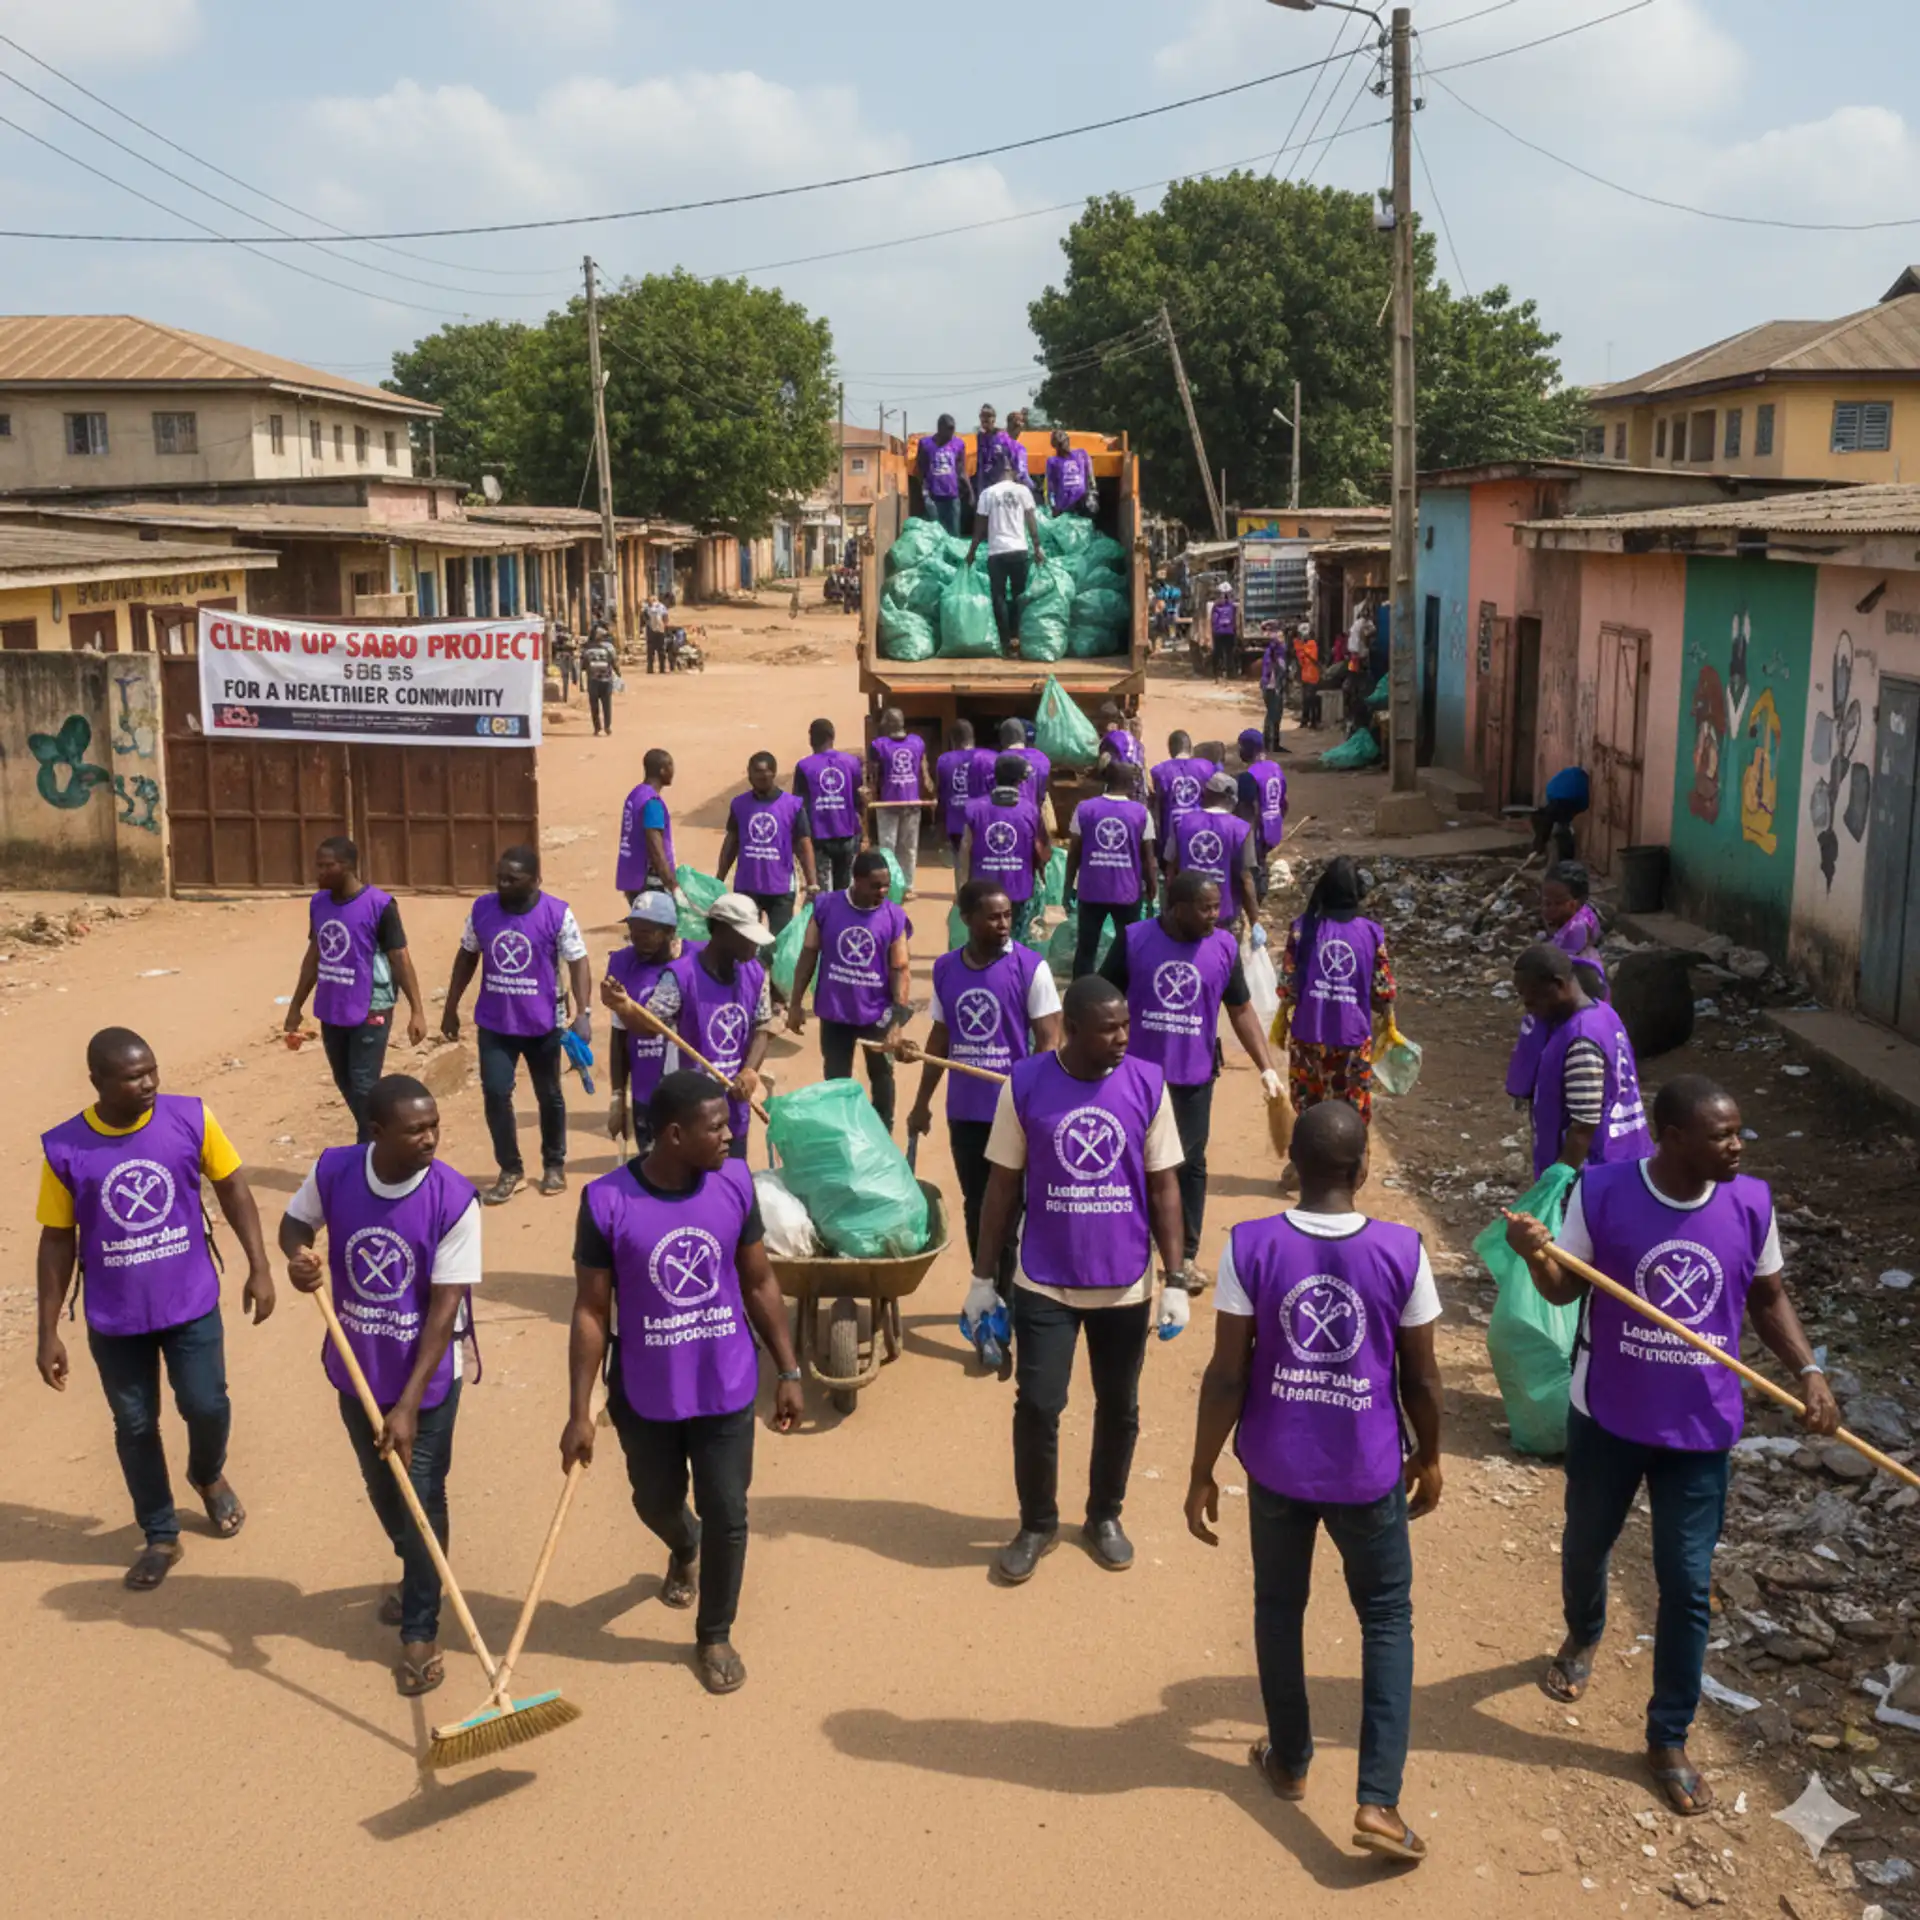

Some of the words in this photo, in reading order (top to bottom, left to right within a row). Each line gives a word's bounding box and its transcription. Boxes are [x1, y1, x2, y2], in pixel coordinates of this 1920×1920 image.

[209, 622, 291, 653] CLEAN
[301, 631, 337, 655] UP
[345, 632, 418, 659] SABO
[427, 632, 543, 661] PROJECT
[223, 679, 260, 699] FOR
[266, 682, 280, 701] A
